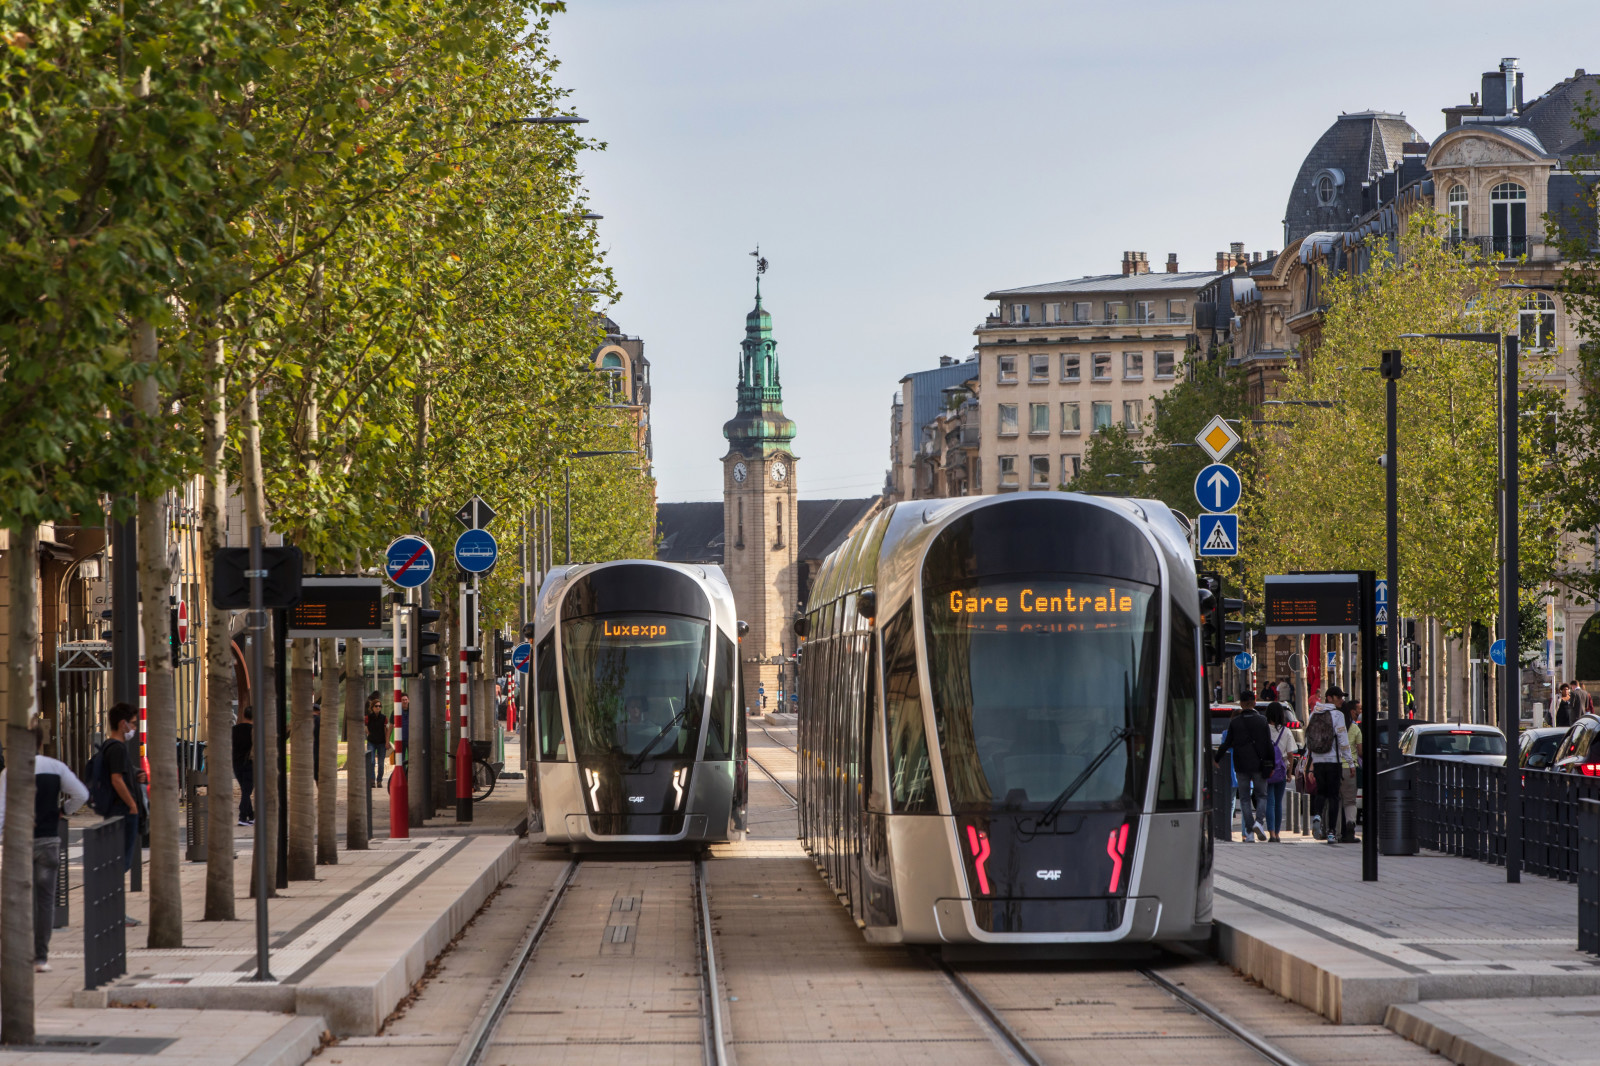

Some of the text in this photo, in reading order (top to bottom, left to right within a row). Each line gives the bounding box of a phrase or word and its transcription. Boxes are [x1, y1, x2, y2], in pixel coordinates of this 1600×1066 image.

[950, 588, 1132, 613] Gare Centrale
[604, 620, 667, 639] Luxexpo
[1036, 869, 1062, 881] CAF
